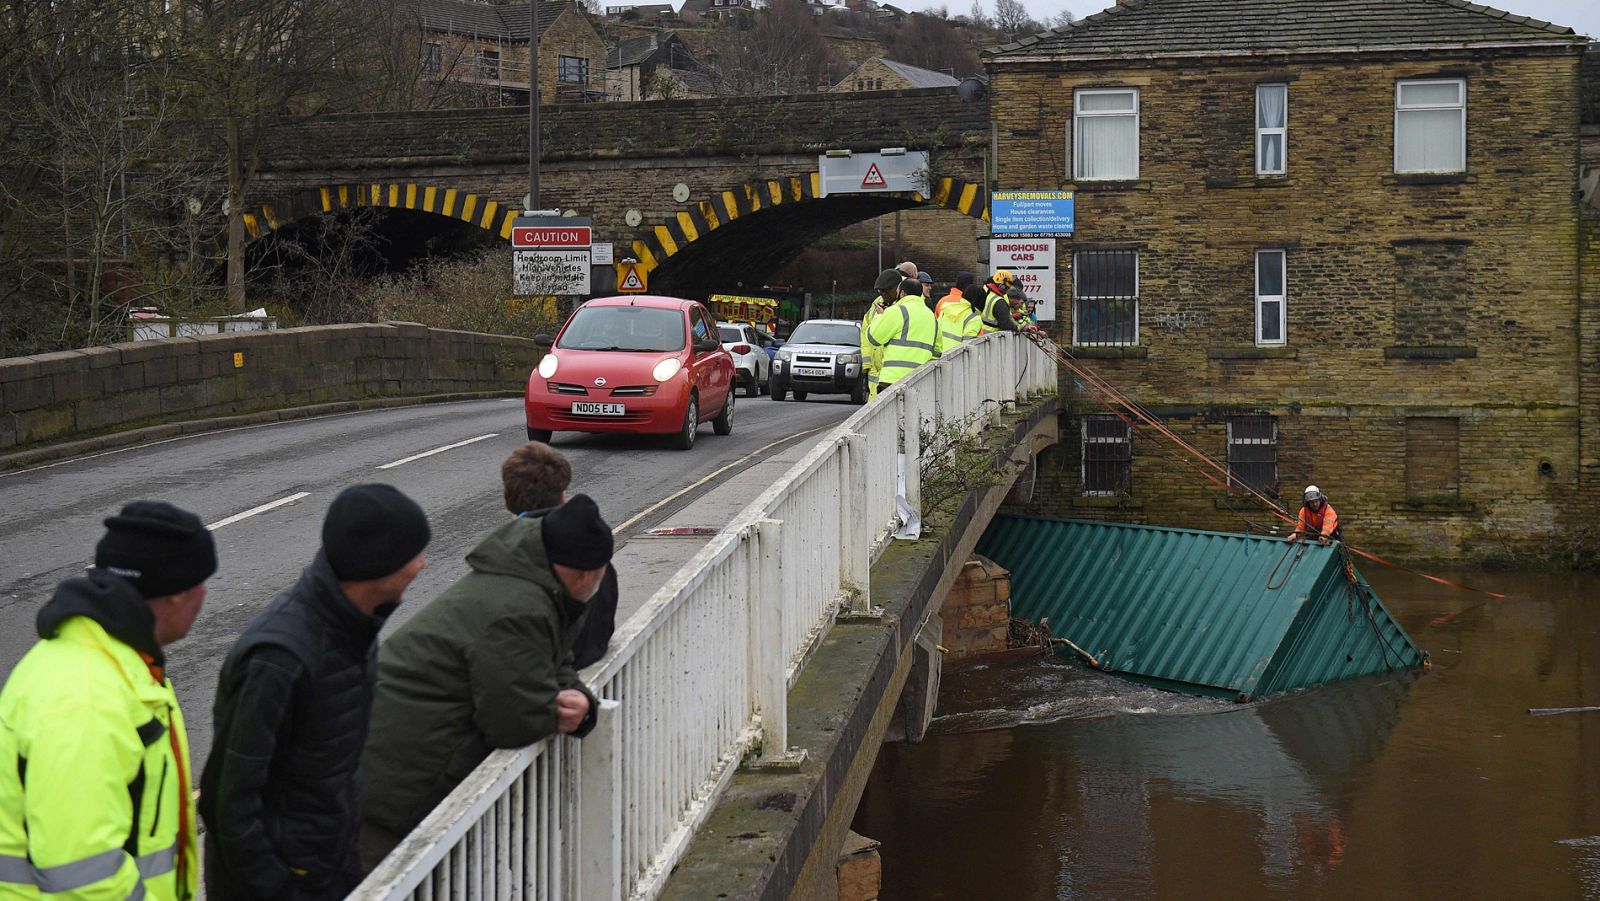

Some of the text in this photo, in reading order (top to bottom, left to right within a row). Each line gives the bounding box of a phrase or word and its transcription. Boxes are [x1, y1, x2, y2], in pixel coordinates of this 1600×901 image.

[993, 191, 1073, 200] HARVEYSREMOVALS.COM
[525, 232, 579, 242] CAUTION
[996, 244, 1049, 252] BRIGHOUSE
[517, 254, 587, 262] Headroom Limit
[1011, 253, 1035, 261] CARS
[545, 264, 582, 272] Vehicles
[520, 273, 542, 282] Keep
[554, 273, 584, 281] middle
[1020, 274, 1038, 282] 484
[1024, 285, 1042, 293] 777
[602, 404, 621, 413] EJL
